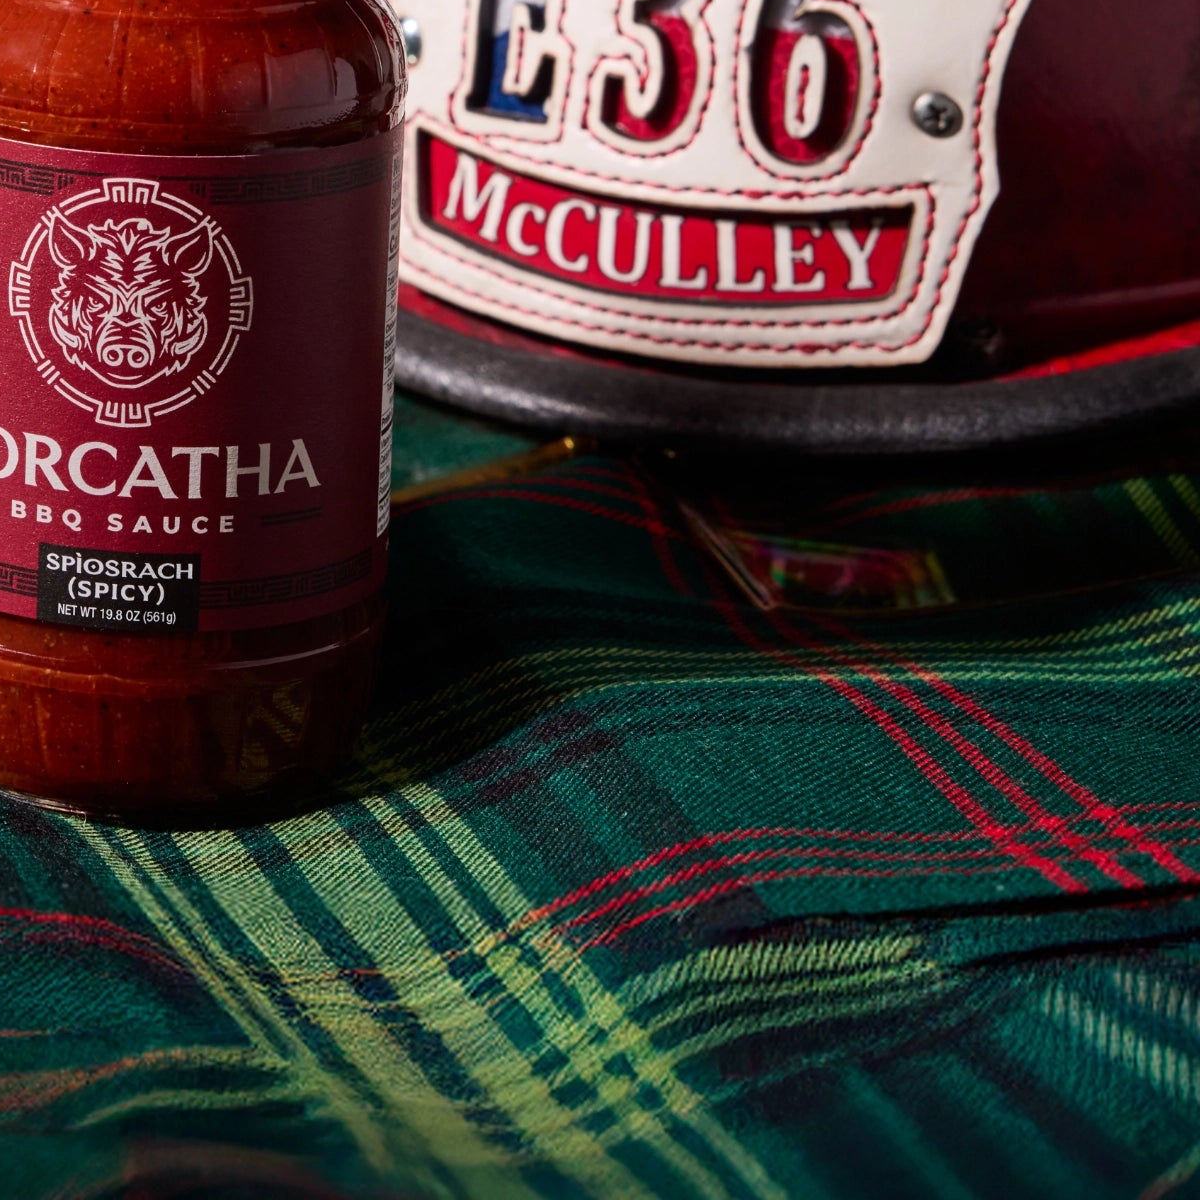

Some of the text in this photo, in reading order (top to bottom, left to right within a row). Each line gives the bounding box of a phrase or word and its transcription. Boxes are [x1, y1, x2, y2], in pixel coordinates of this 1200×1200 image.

[442, 154, 887, 293] McCULLEY
[10, 499, 235, 535] BBQ SAUCE
[67, 576, 165, 606] (SPICY)
[57, 603, 176, 625] NET WT 19.8 OZ (561g)
